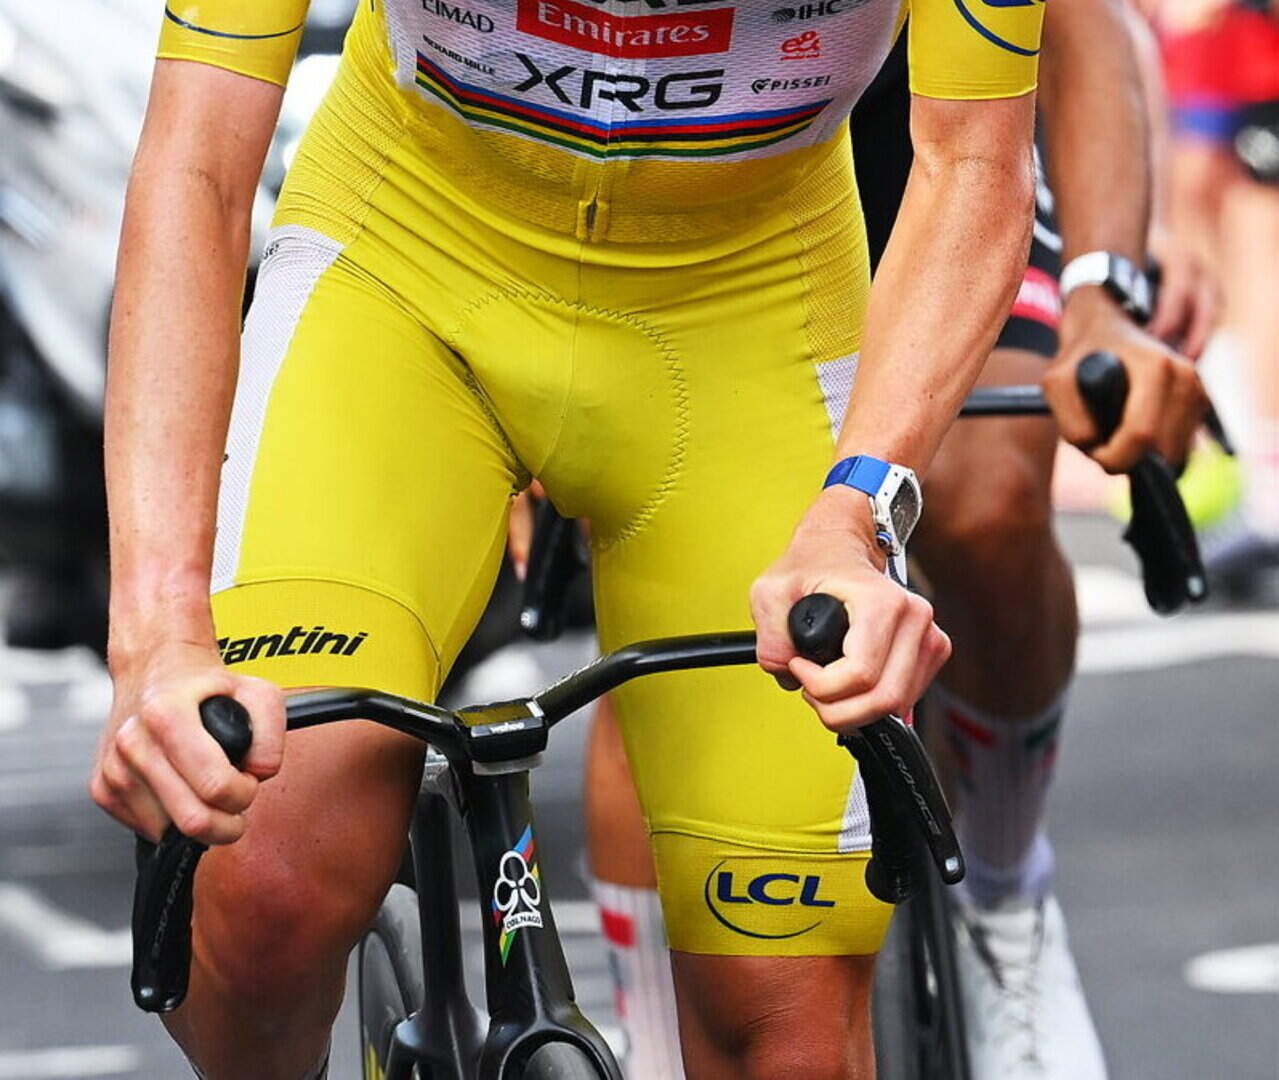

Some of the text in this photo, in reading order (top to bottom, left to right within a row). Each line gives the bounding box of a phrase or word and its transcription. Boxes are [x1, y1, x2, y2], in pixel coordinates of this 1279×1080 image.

[537, 1, 710, 48] Emirates
[799, 0, 842, 20] IHC
[512, 51, 725, 113] XRG
[770, 75, 831, 91] PISSEI
[717, 871, 836, 908] LCL
